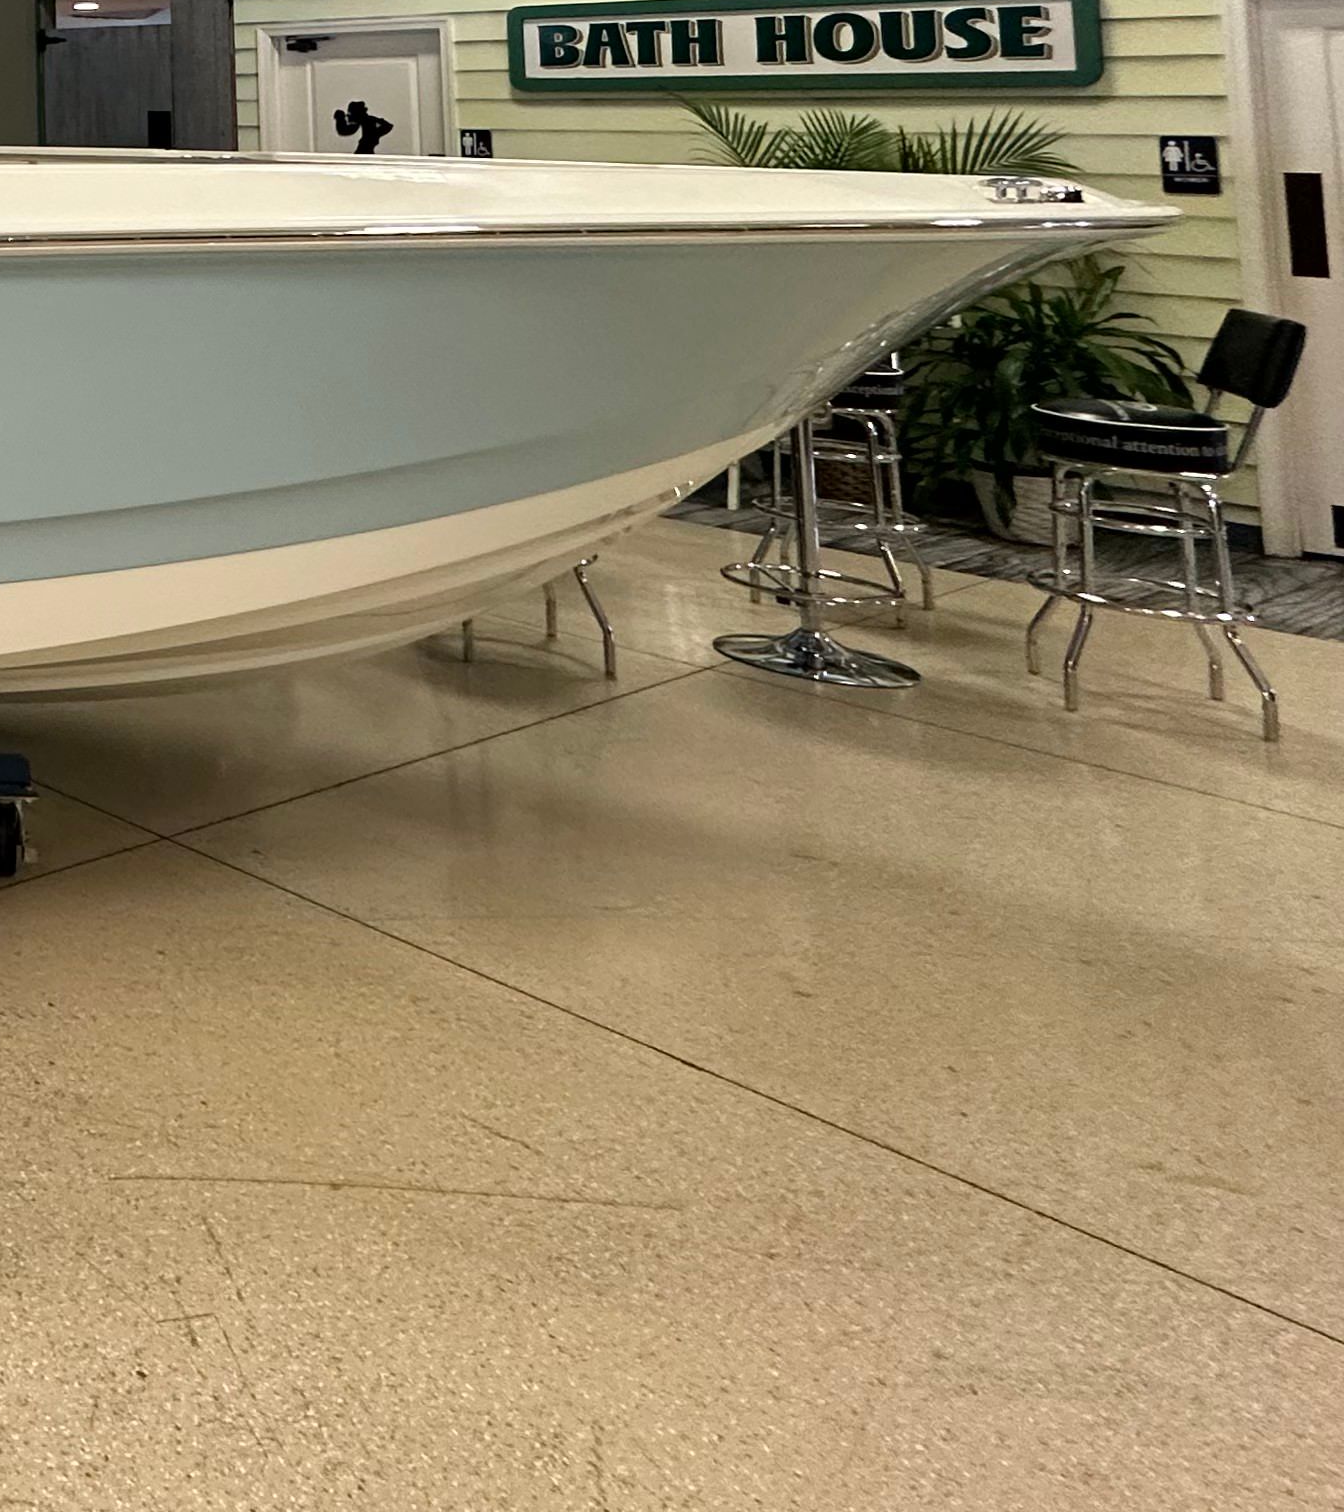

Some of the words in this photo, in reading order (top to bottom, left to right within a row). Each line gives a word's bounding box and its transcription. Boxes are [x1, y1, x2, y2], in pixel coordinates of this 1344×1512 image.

[538, 19, 724, 67] BATH
[755, 6, 1053, 65] HOUSE
[1122, 440, 1200, 457] attention
